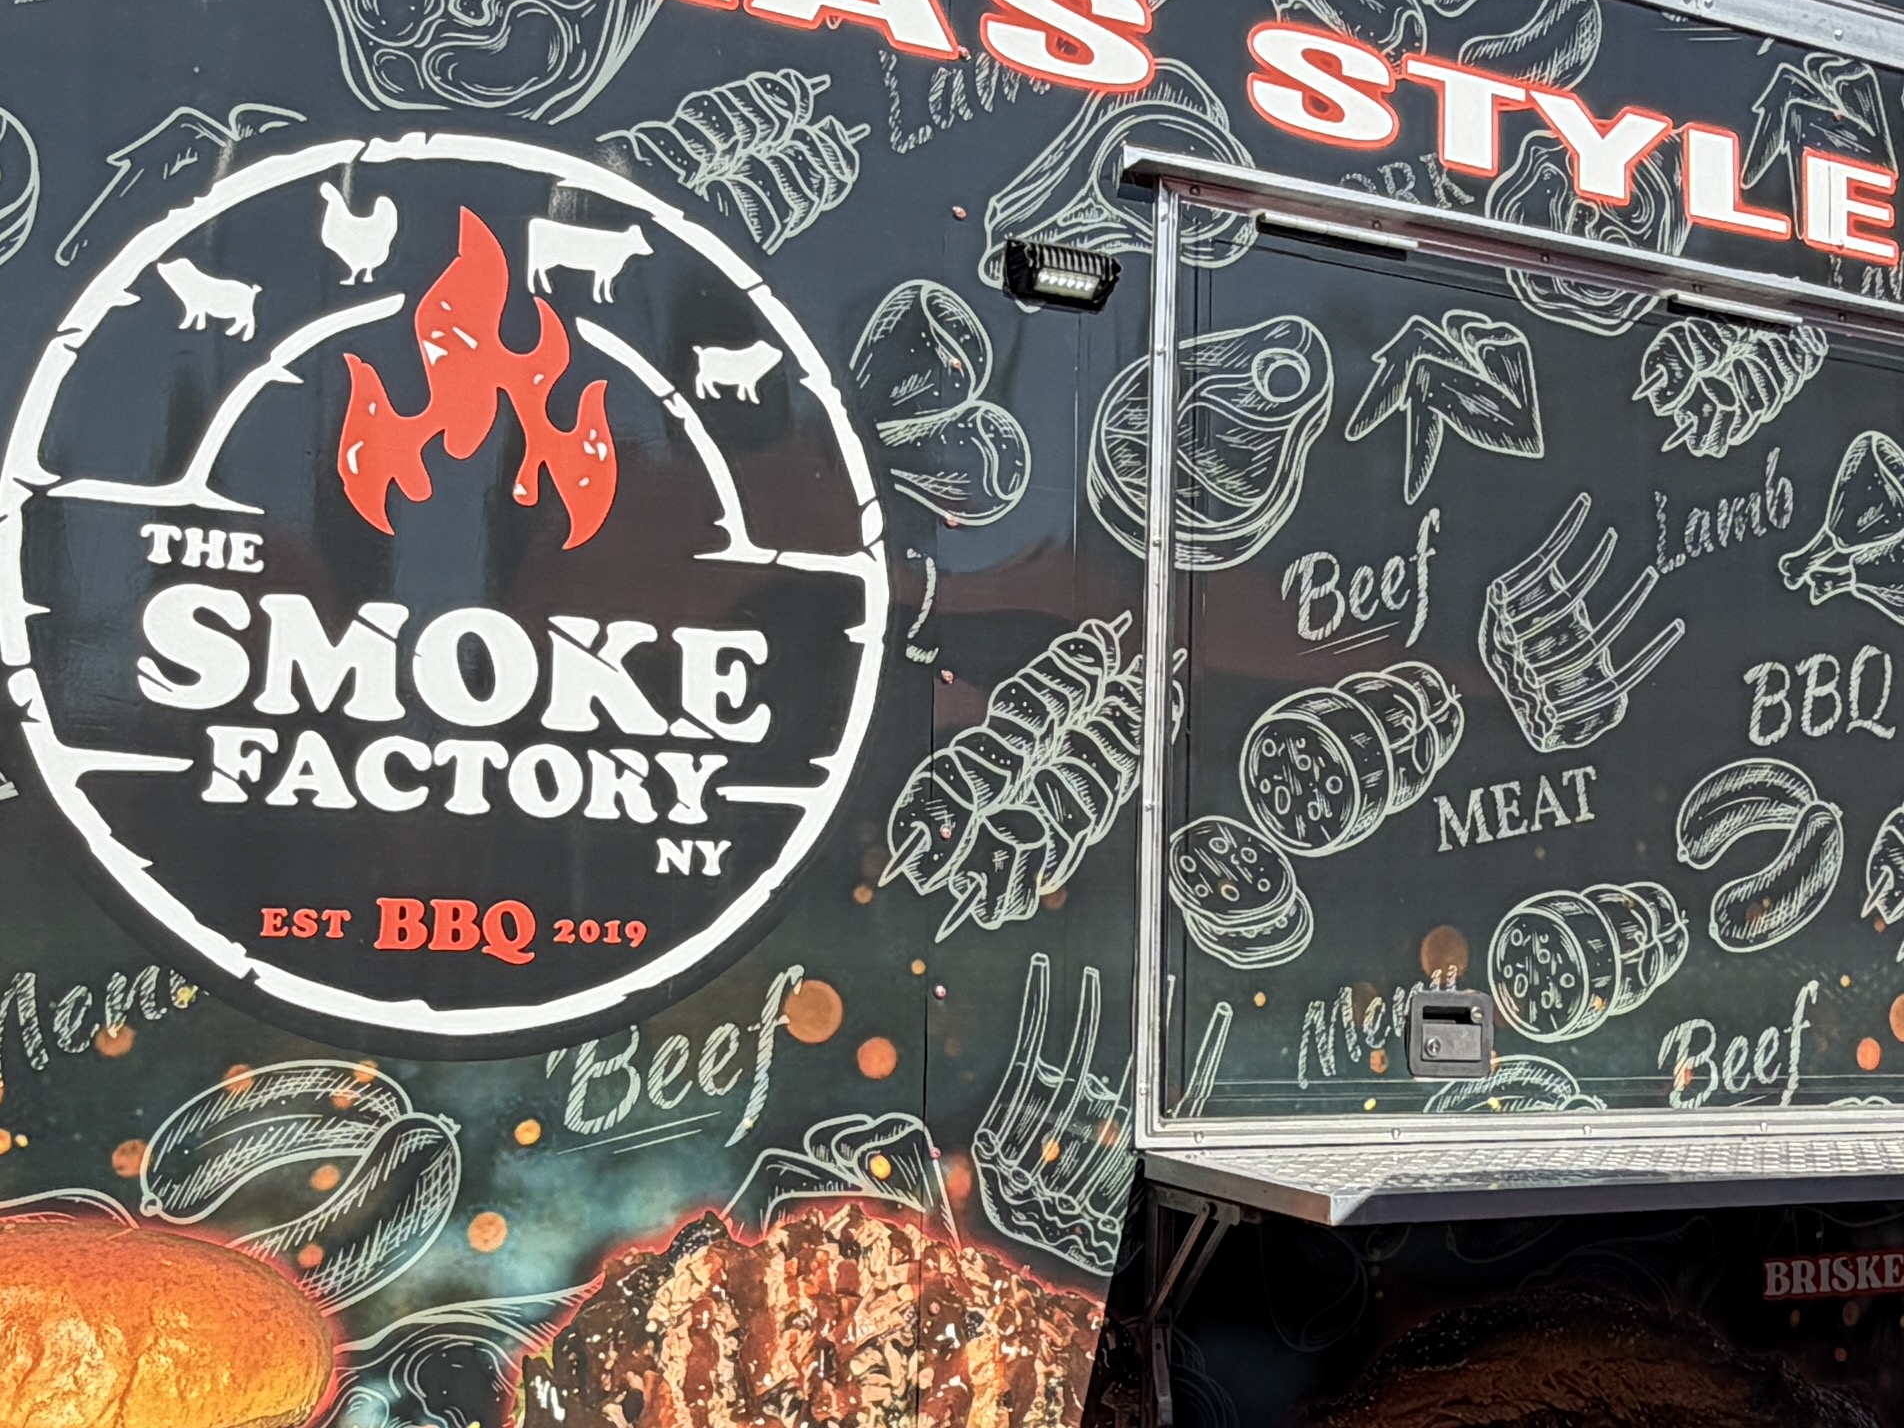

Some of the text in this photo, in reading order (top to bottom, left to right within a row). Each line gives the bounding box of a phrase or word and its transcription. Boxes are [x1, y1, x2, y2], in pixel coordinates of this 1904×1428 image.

[1253, 28, 1899, 261] STYLE
[141, 523, 265, 573] THE
[1653, 447, 1794, 574] Lamb
[1281, 507, 1440, 648] Beef
[137, 583, 772, 743] SMOKE
[1743, 644, 1897, 747] BBQ
[201, 724, 728, 825] FACTORY
[1434, 766, 1597, 853] MEAT
[655, 839, 732, 878] NY
[260, 897, 648, 965] EST BBQ 2019
[547, 964, 805, 1147] Beef
[1658, 980, 1819, 1110] Beef
